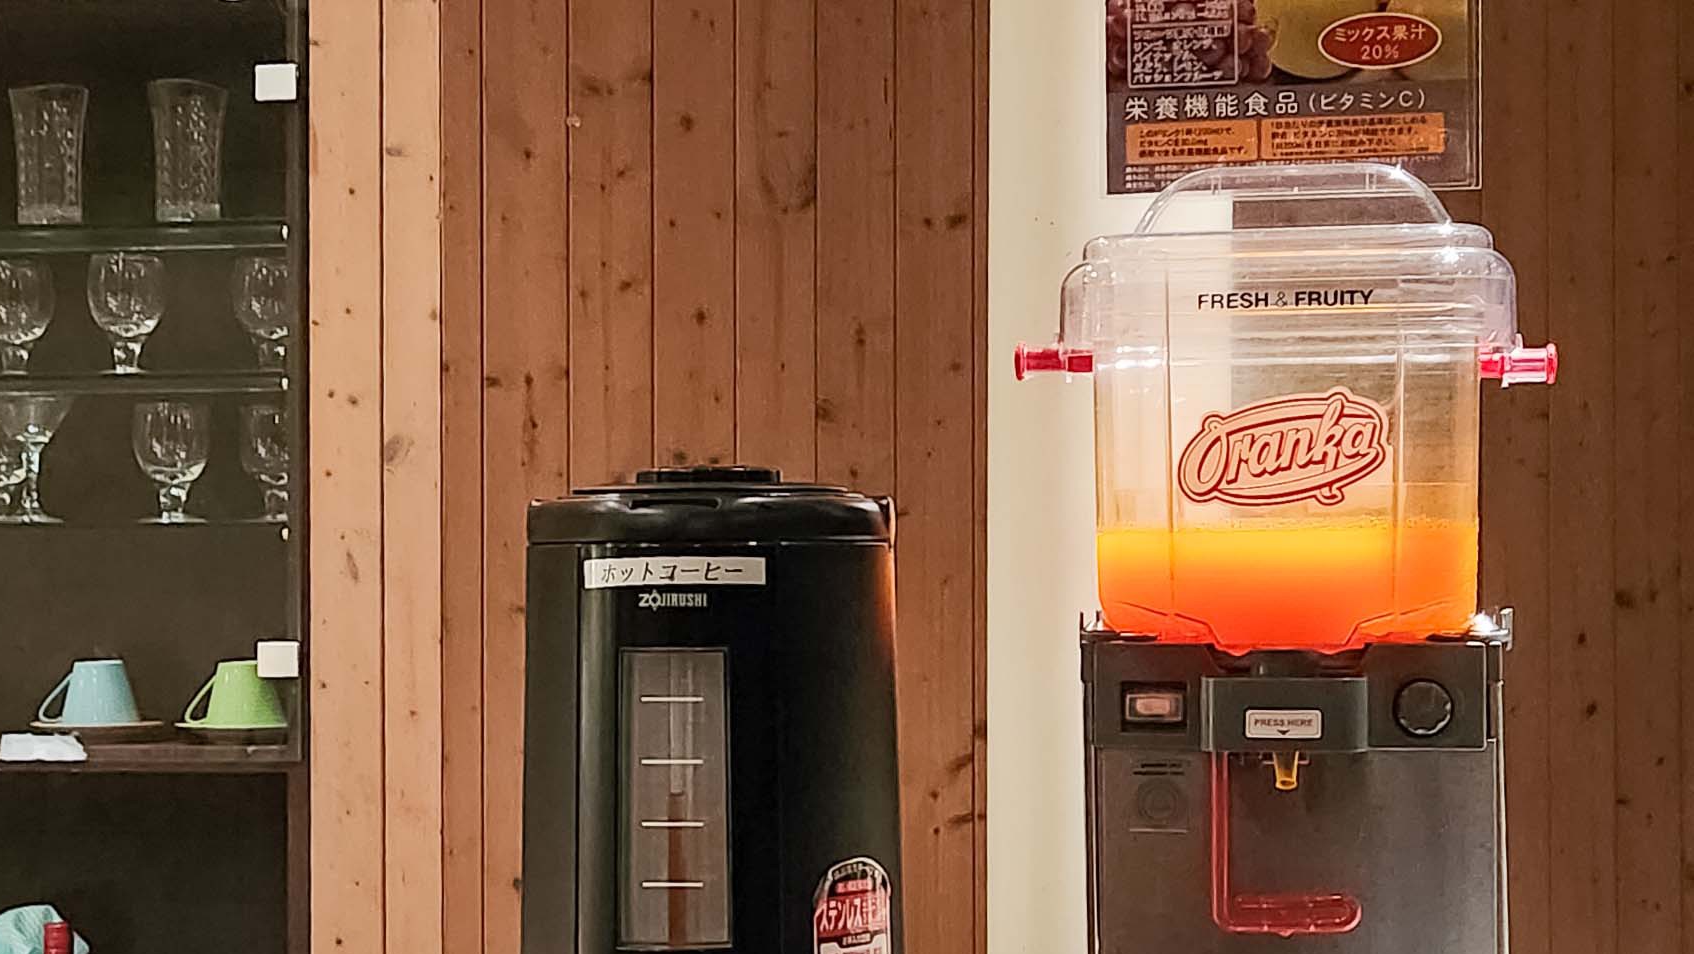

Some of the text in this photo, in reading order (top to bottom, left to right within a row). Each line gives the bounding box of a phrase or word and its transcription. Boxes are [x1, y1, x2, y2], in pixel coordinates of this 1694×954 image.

[1335, 24, 1427, 42] ミックス果汁
[1361, 44, 1399, 60] 20%
[1198, 289, 1374, 310] FRESH & FRUITY
[1181, 395, 1383, 503] Oranka
[601, 561, 746, 584] ホットコーヒー
[638, 589, 708, 611] ZOJIRUSHI
[1254, 718, 1314, 728] PRESS HERE
